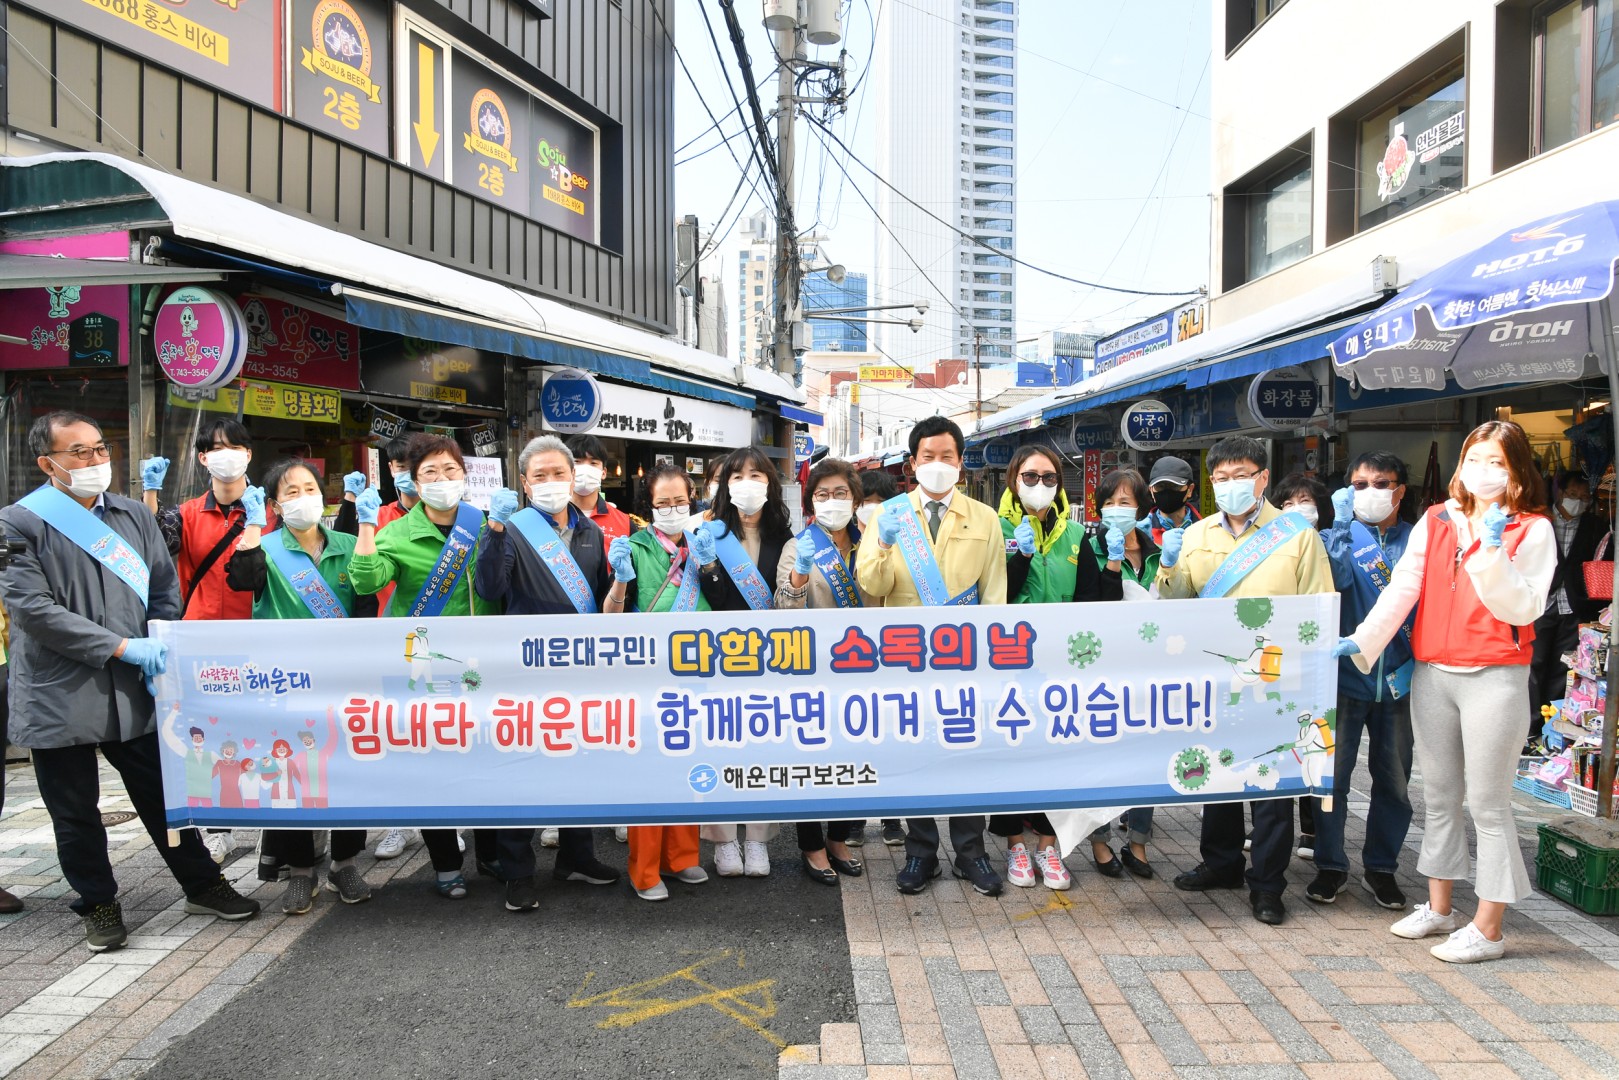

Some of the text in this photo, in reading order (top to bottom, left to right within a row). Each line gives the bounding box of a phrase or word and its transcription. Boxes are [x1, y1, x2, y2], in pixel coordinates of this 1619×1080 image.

[185, 23, 217, 57] 비어
[320, 57, 340, 74] SOJU
[346, 71, 366, 87] BEER
[323, 86, 362, 131] 2층
[1417, 112, 1465, 153] 연남물갈
[476, 140, 490, 152] SOJU
[494, 148, 508, 159] BEER
[538, 140, 566, 167] Soju
[479, 162, 505, 197] 2층
[559, 164, 589, 192] Beer
[1471, 233, 1588, 278] HOT6
[1442, 300, 1475, 323] 핫한
[84, 330, 104, 349] 38
[246, 361, 299, 379] 743-3545
[431, 352, 472, 382] Beer
[283, 389, 339, 420] 명품호떡
[449, 389, 463, 402] 비어
[1262, 388, 1313, 408] 화장품
[372, 417, 402, 437] OPEN
[1133, 413, 1168, 427] 아궁이
[1134, 426, 1163, 440] 식당
[473, 429, 496, 446] OPEN
[1087, 453, 1098, 489] 가정식
[437, 549, 455, 576] 함께하면
[452, 548, 467, 570] 힘내라
[431, 576, 441, 590] 이겨
[521, 620, 1037, 677] 해운대구민! 다함께 소독의 날
[200, 667, 240, 681] 사람중심
[246, 667, 311, 695] 해운대
[202, 682, 242, 693] 미래도시
[343, 680, 1216, 756] 힘내라 해운대! 함께하면 이겨 낼 수 있습니다!
[723, 763, 878, 789] 해운대구보건소
